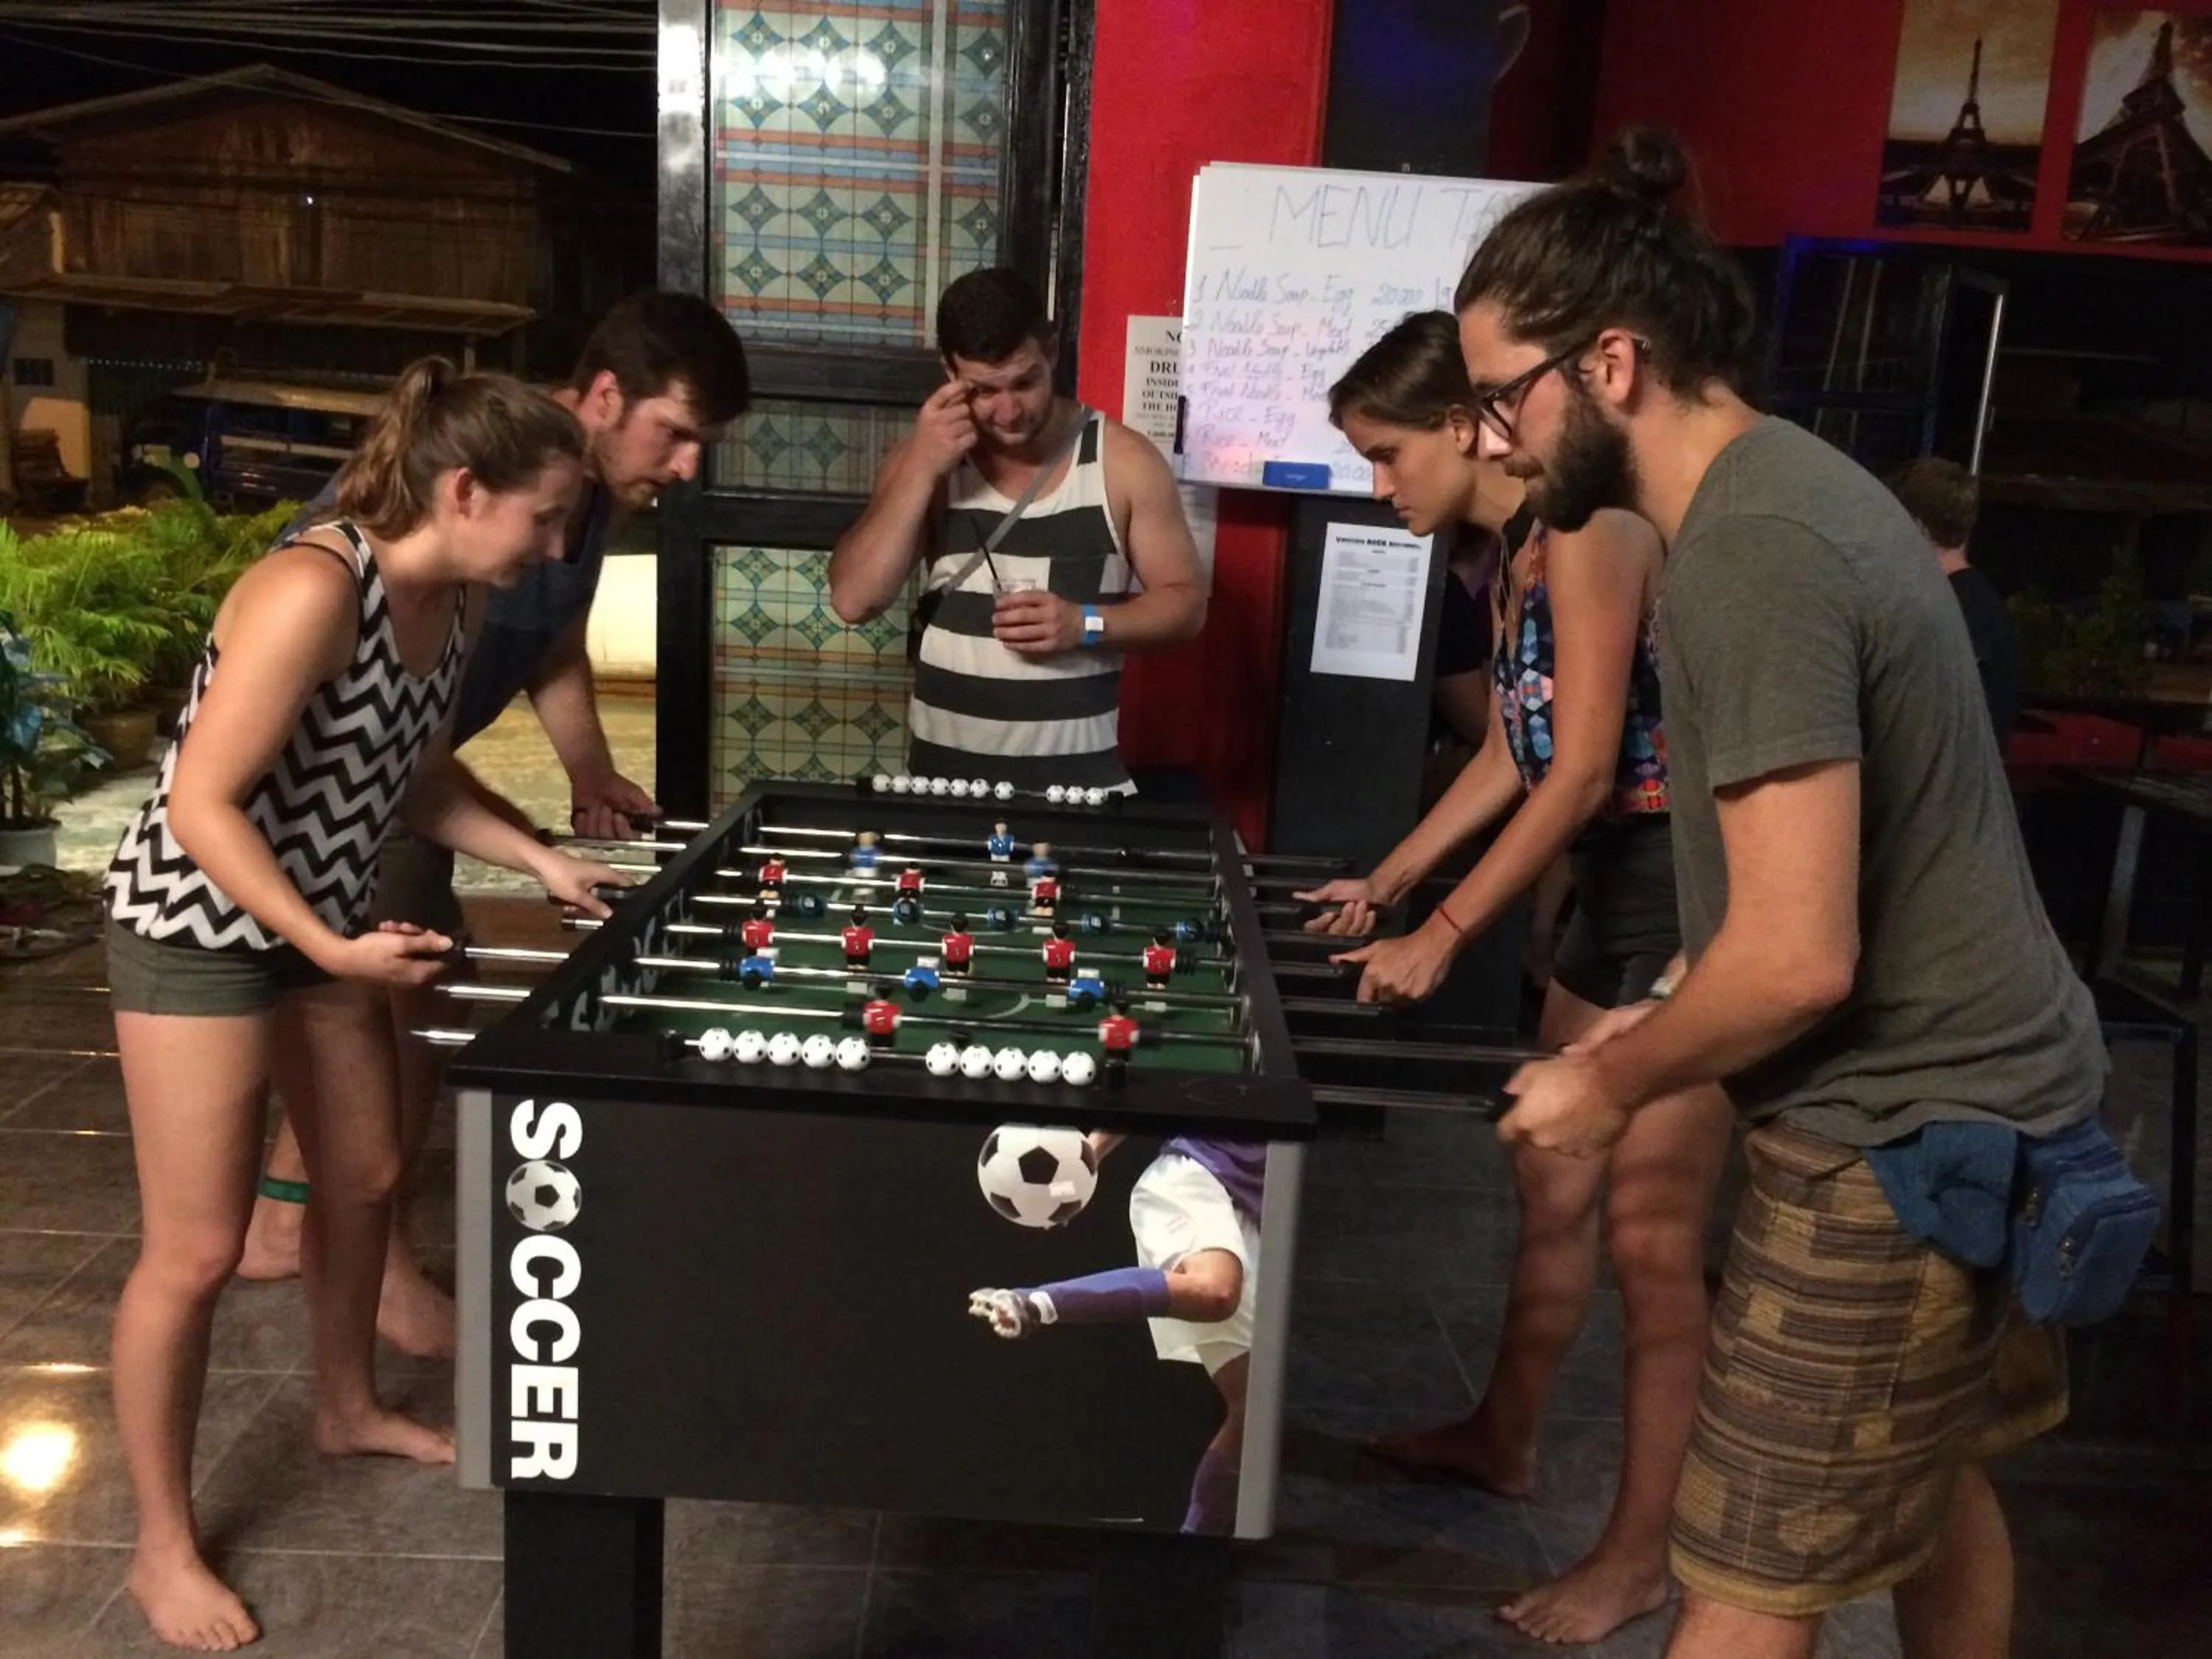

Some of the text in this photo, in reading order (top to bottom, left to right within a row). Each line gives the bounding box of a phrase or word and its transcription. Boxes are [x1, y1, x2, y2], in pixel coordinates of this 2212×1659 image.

[1269, 184, 1424, 251] MENU
[1270, 272, 1310, 307] Soup
[1266, 310, 1301, 341] Soup
[1208, 336, 1253, 359] Noodle
[1256, 338, 1290, 361] Soup
[1300, 364, 1326, 389] Egg
[1263, 406, 1297, 442] Egg
[505, 1099, 583, 1481] SOCCER
